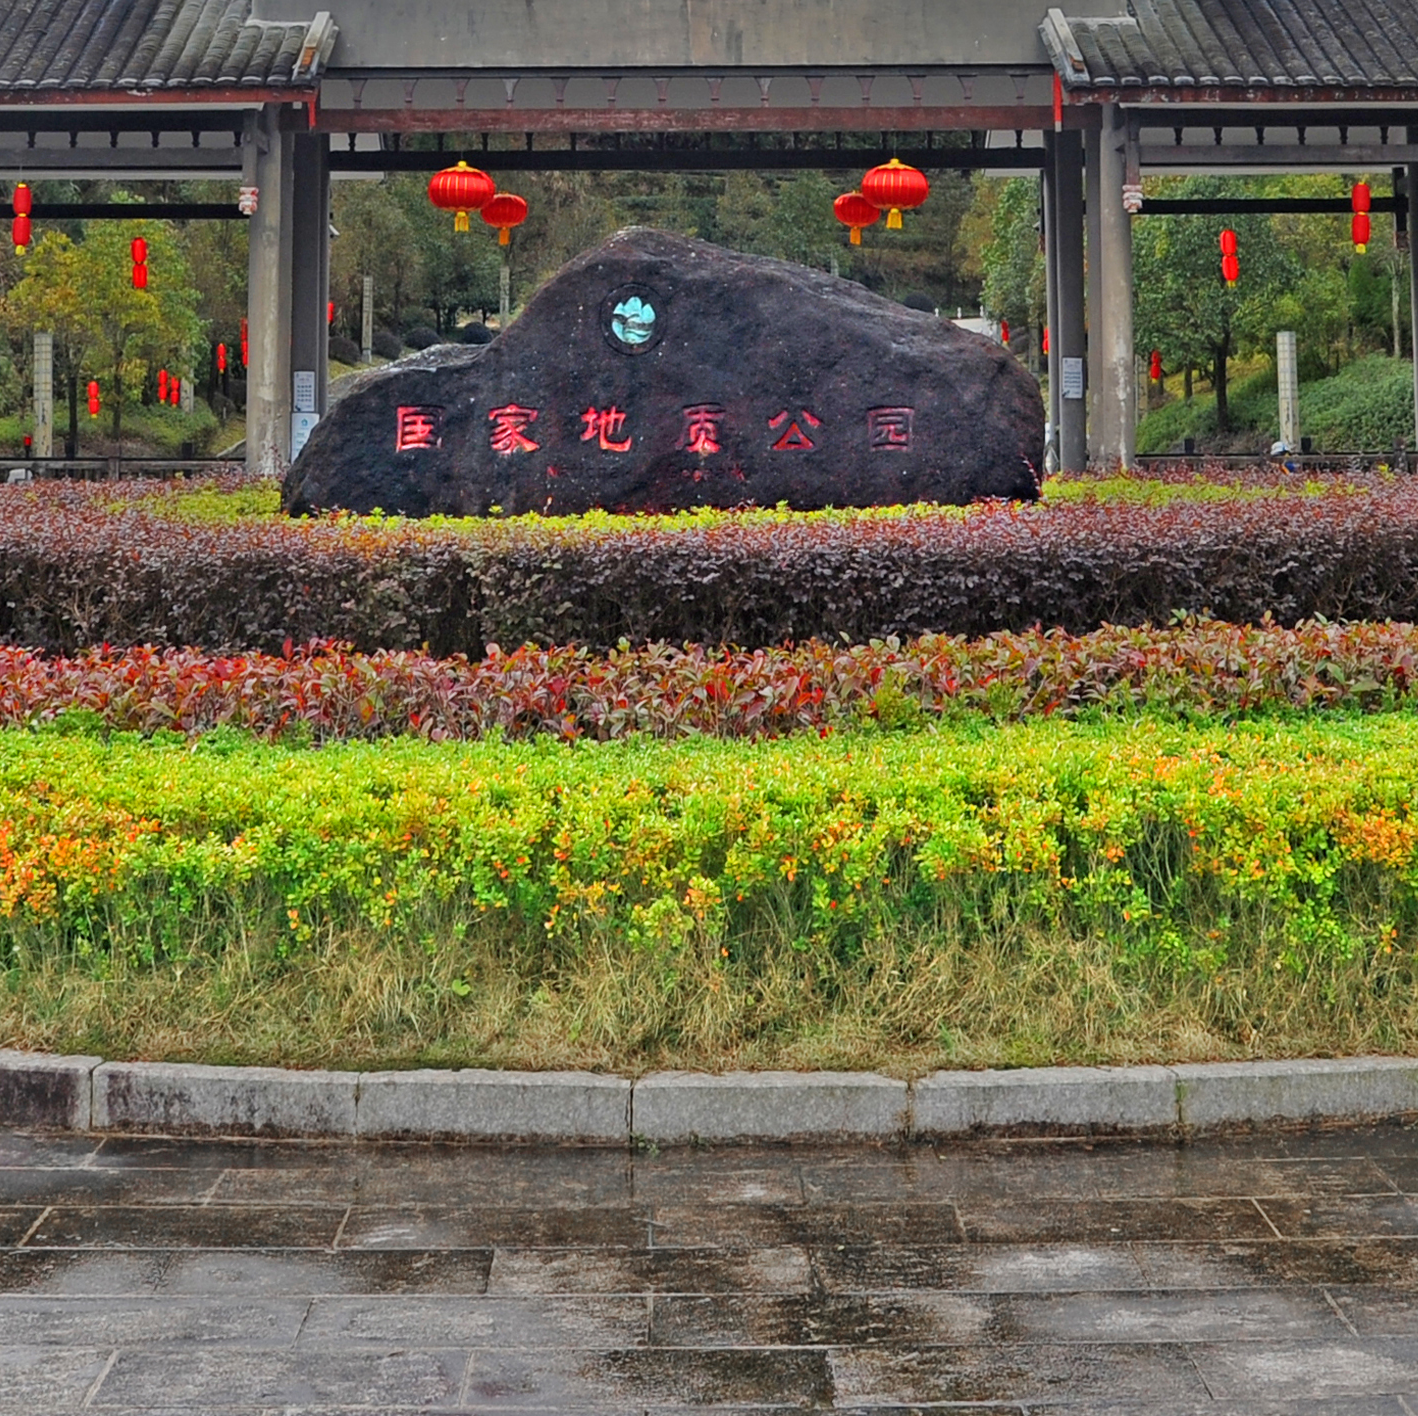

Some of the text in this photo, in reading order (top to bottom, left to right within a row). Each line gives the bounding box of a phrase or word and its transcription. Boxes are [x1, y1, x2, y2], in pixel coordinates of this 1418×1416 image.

[395, 402, 916, 453] 国家地质公园
